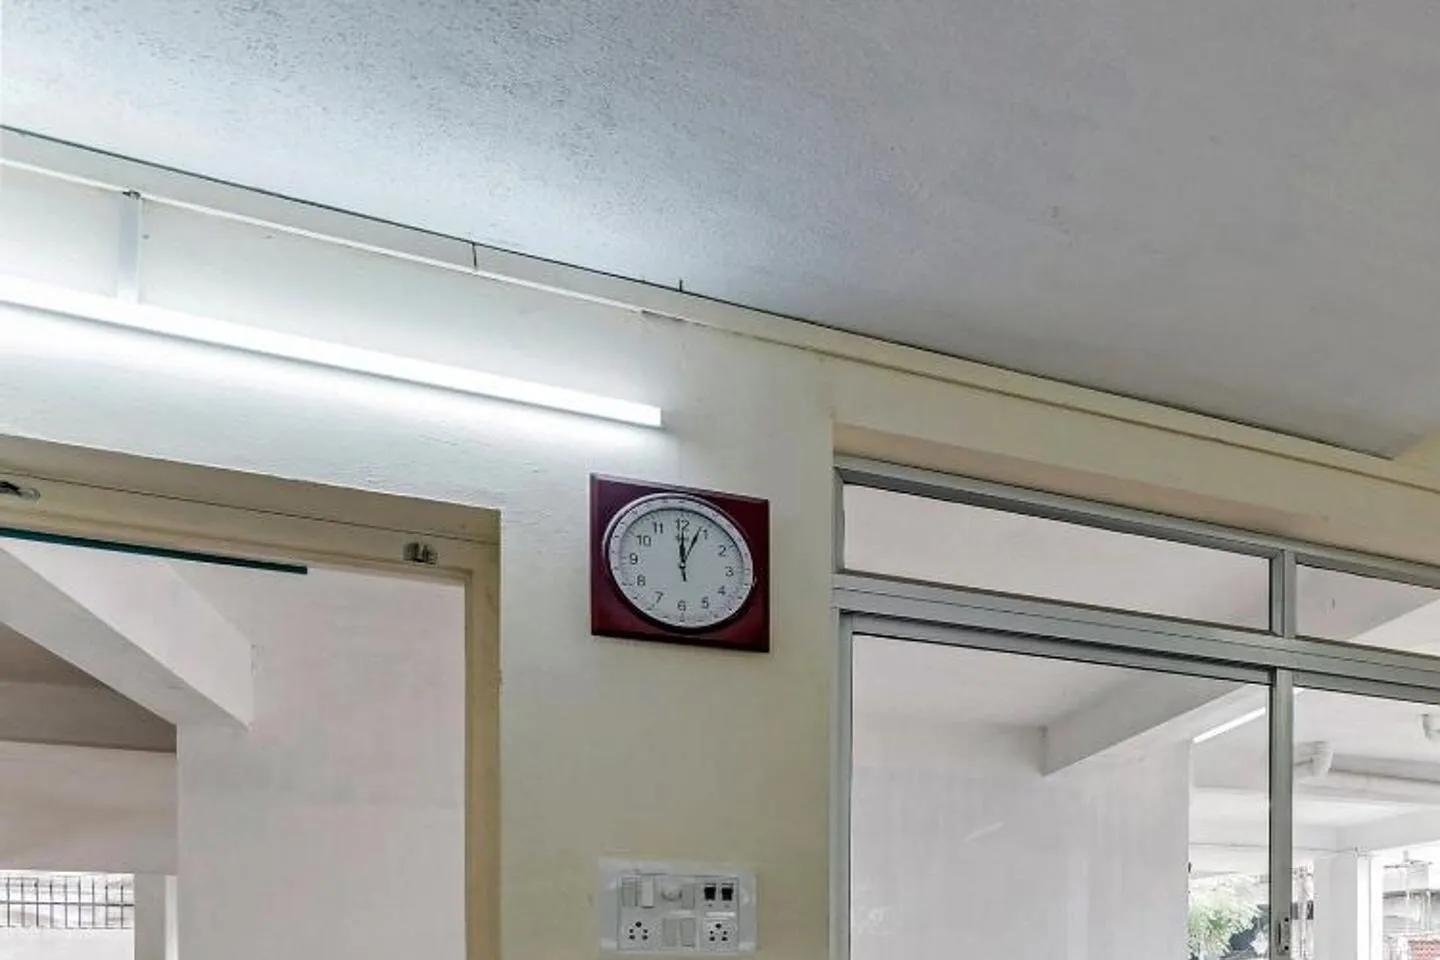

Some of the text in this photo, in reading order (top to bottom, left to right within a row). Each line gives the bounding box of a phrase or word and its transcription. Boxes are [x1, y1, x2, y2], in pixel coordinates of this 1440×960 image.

[653, 521, 663, 534] 11
[675, 518, 690, 531] 12
[702, 528, 708, 540] 1
[636, 535, 651, 547] 10
[717, 544, 727, 557] 2
[629, 552, 638, 565] 9
[725, 565, 734, 577] 3
[637, 575, 646, 586] 8
[717, 585, 727, 595] 4
[655, 590, 664, 603] 7
[701, 596, 710, 609] 5
[677, 600, 687, 612] 6
